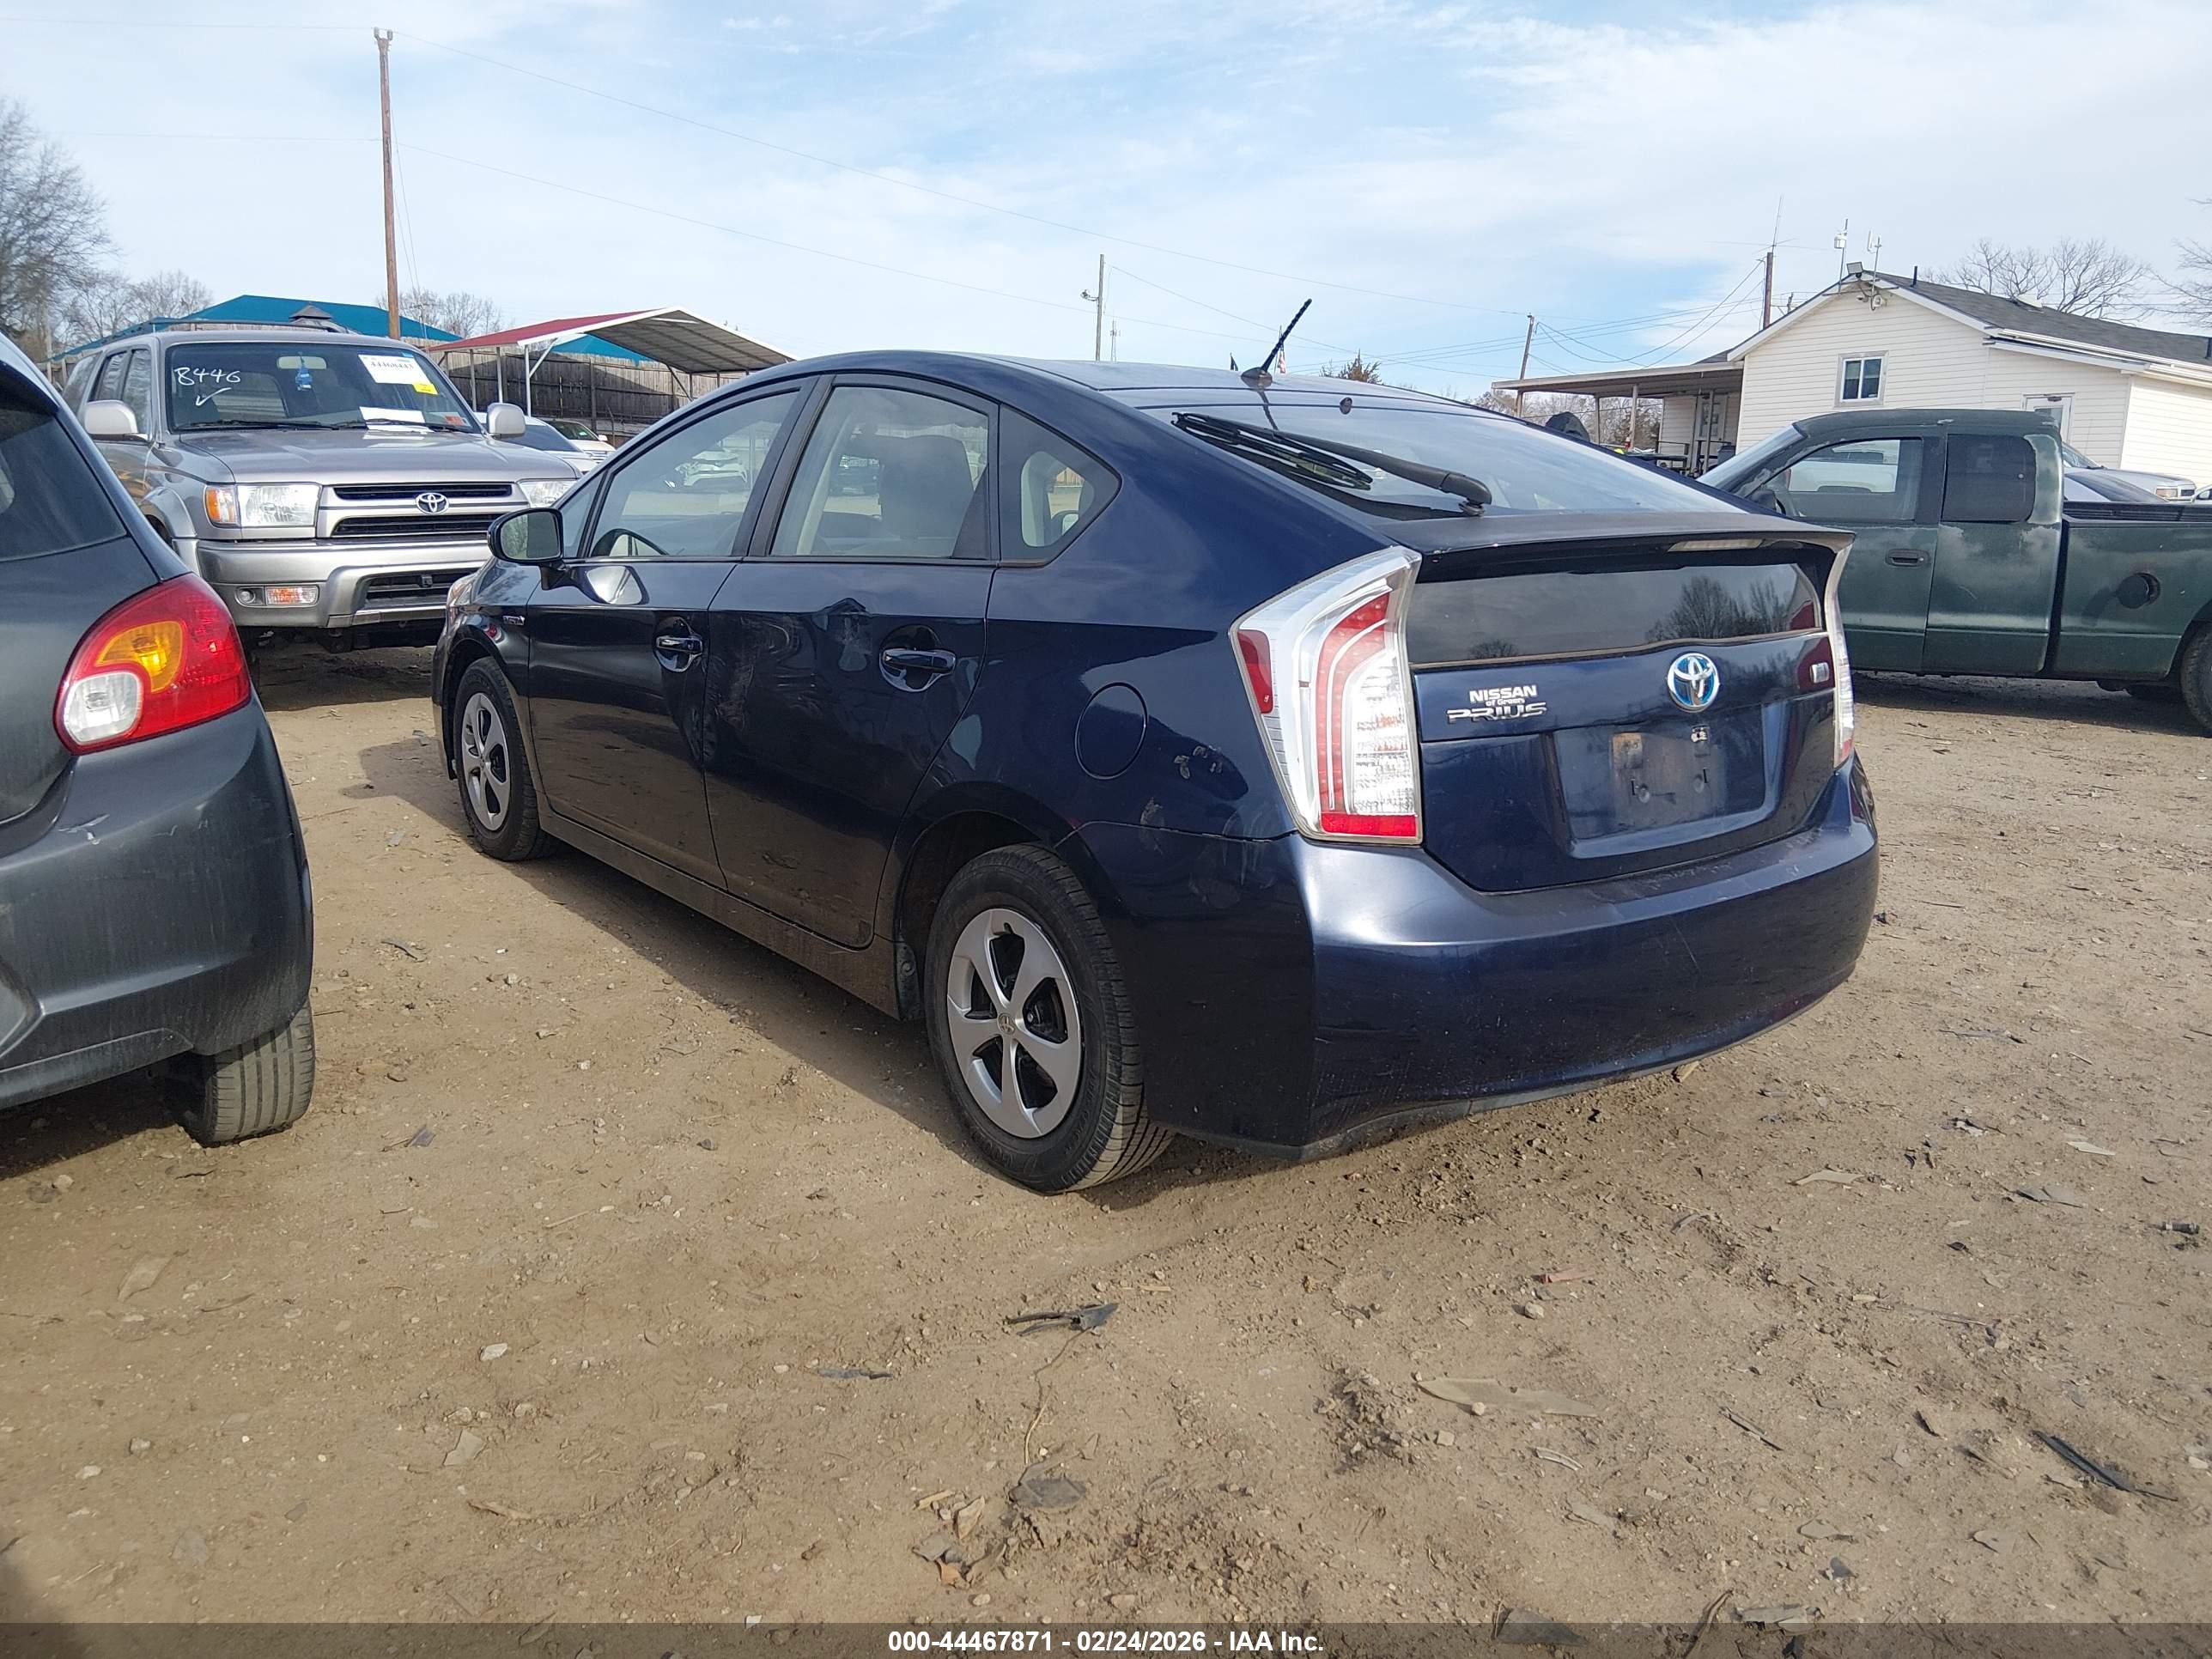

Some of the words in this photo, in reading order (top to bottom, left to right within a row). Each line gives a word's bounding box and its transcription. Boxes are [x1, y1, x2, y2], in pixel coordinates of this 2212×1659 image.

[173, 367, 241, 386] 8446
[1469, 685, 1537, 703] NISSAN
[1447, 702, 1547, 723] PRIUS
